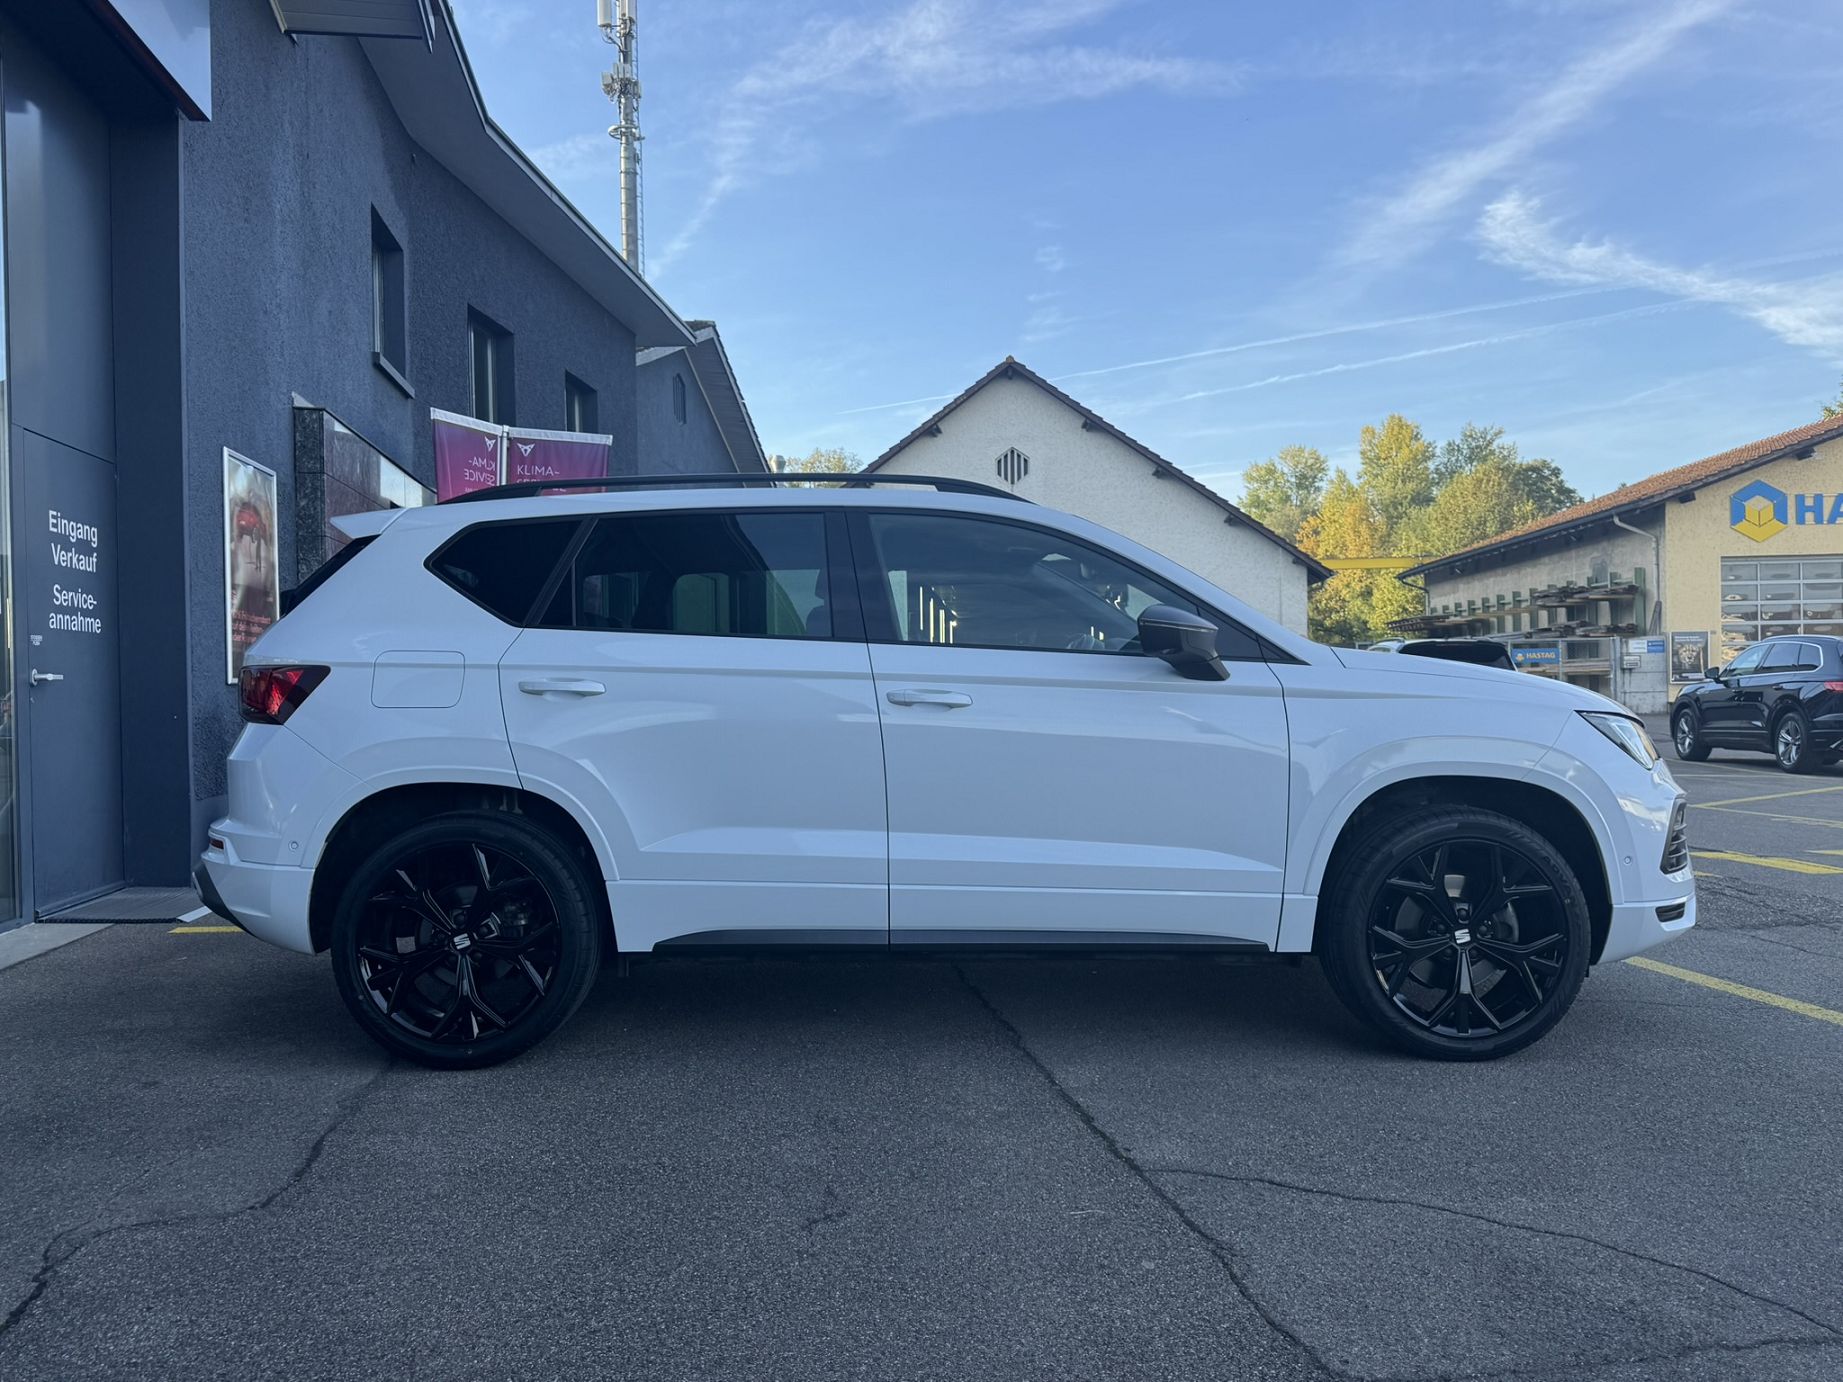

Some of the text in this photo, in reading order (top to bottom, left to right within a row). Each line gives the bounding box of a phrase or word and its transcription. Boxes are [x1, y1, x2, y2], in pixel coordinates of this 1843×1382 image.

[517, 464, 560, 476] KLIMA-
[48, 509, 98, 548] Eingang
[51, 542, 98, 573] Verkauf
[53, 583, 97, 610] Service-
[49, 611, 101, 634] annahme
